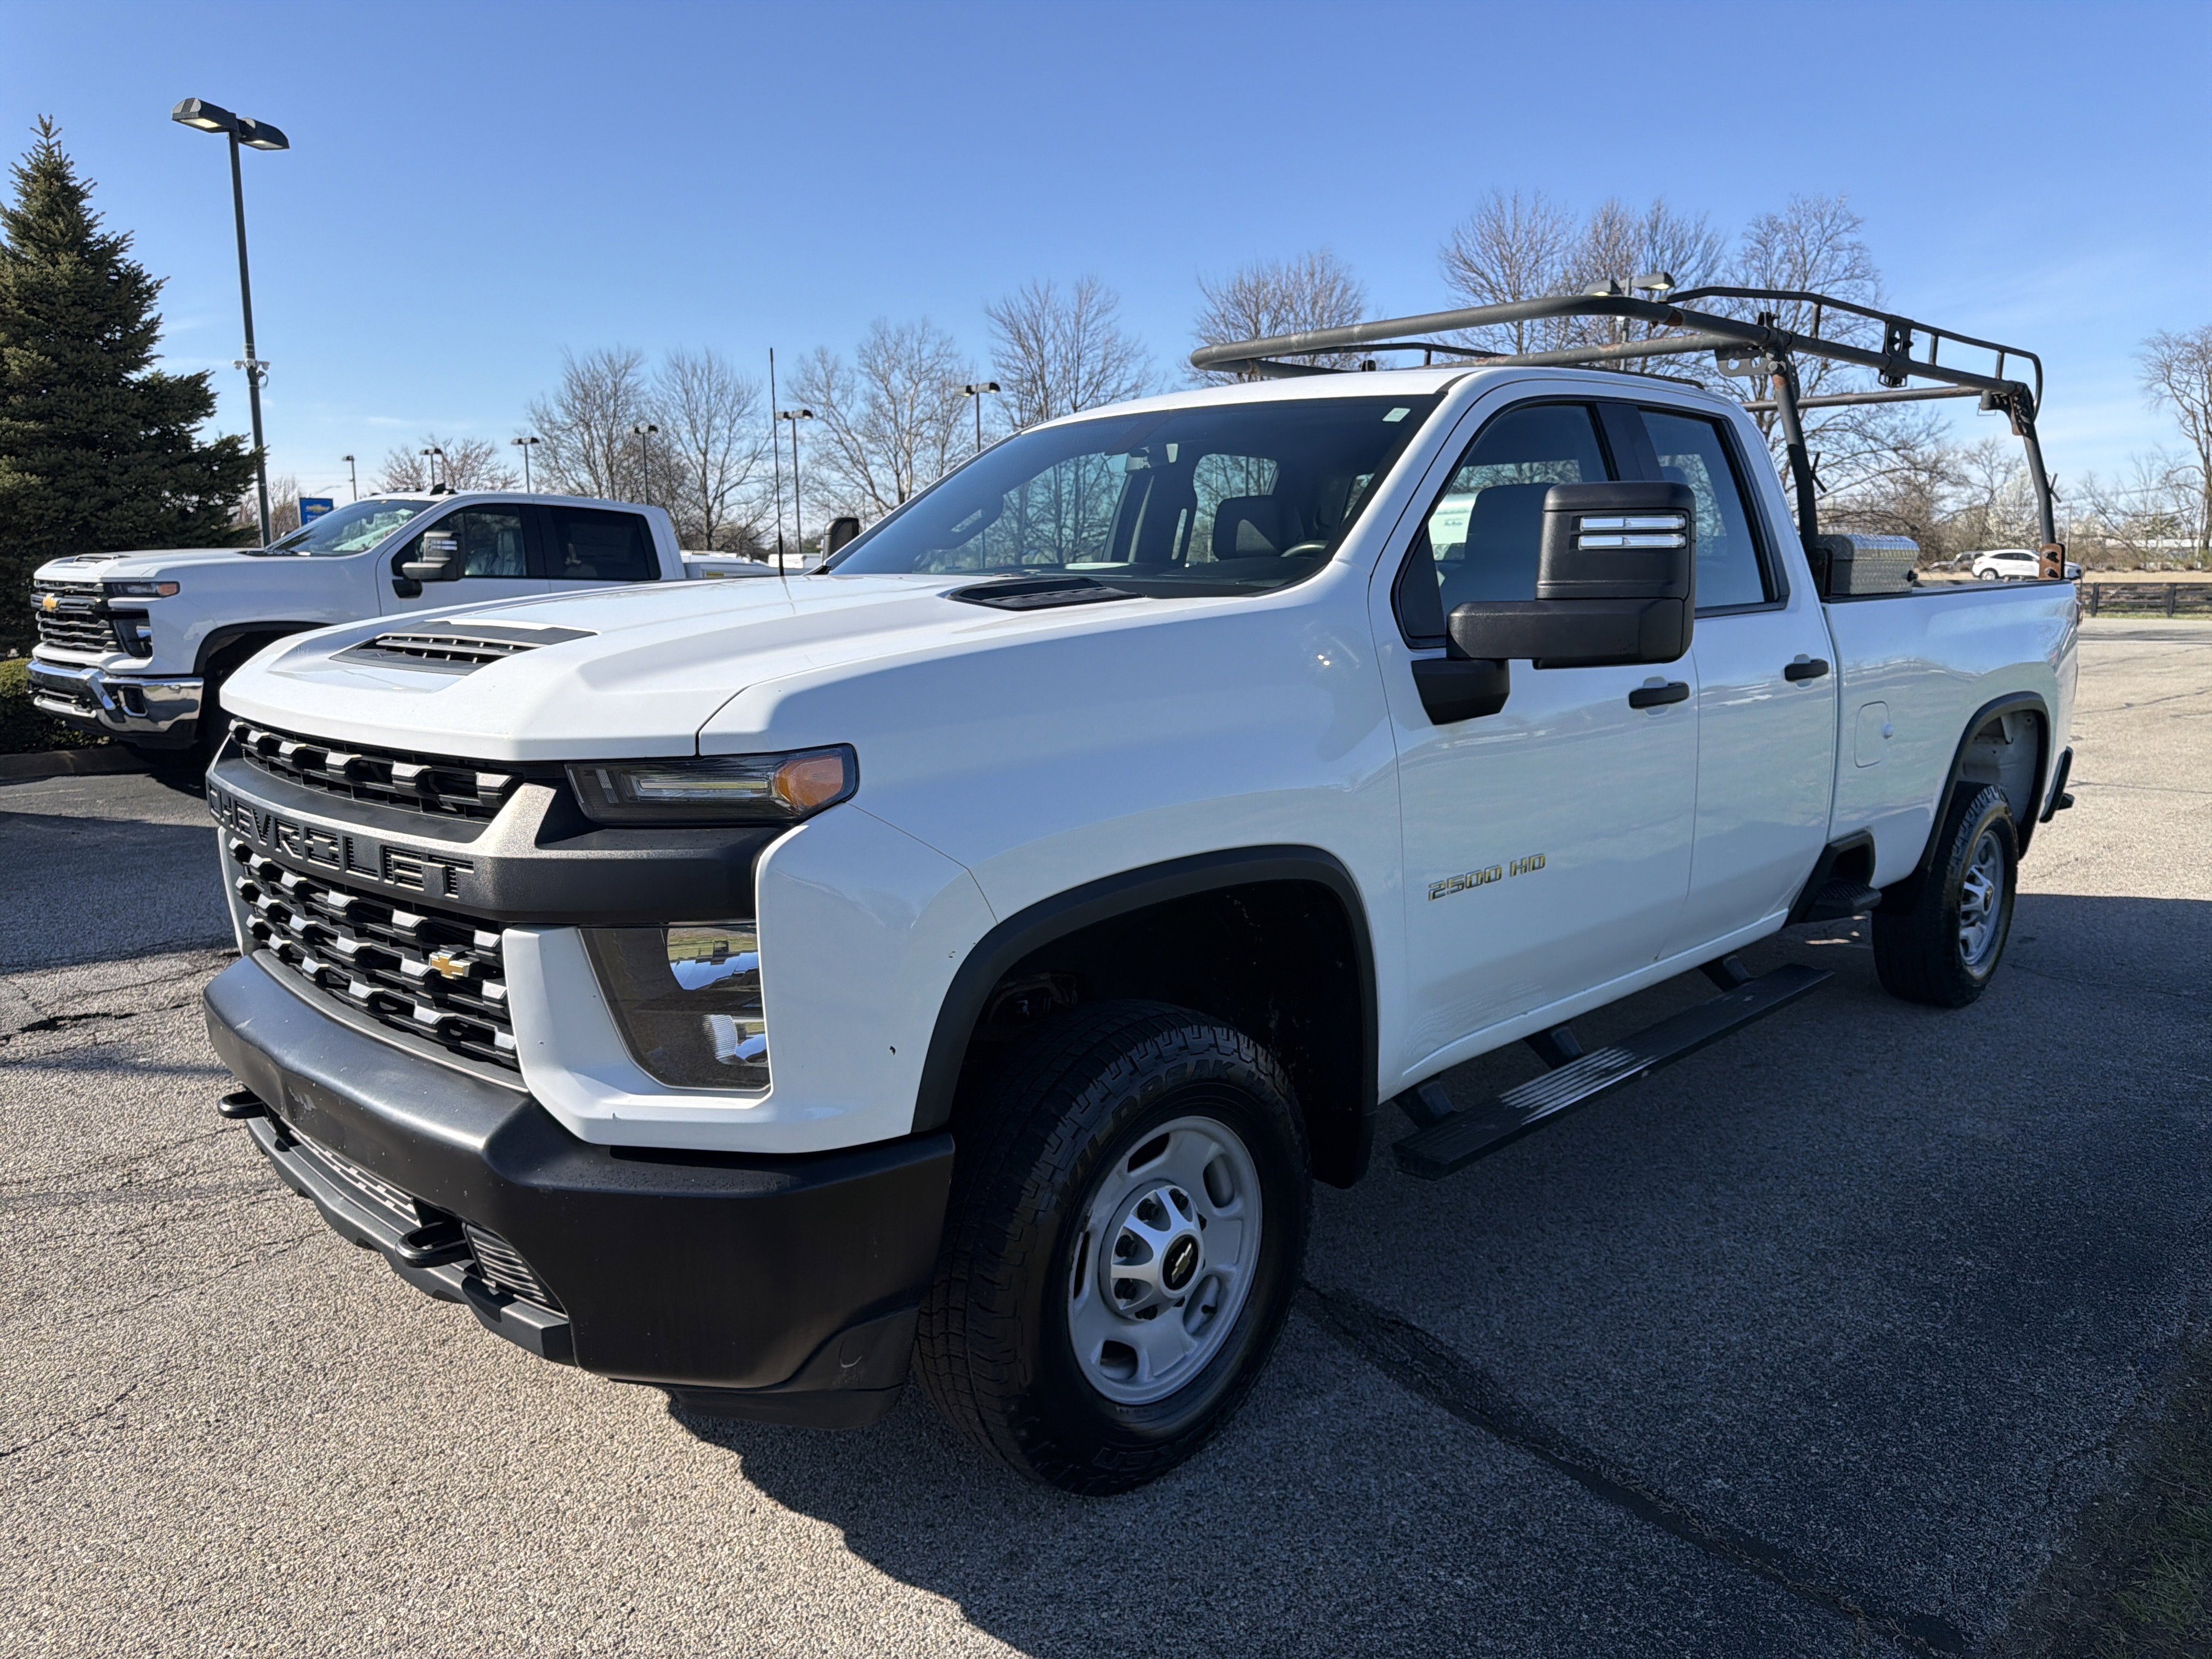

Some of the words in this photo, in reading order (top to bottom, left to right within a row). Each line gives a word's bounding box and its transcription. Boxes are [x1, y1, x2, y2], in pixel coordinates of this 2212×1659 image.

[209, 783, 475, 900] CHEVROLET
[1428, 865, 1503, 901] 2500
[1510, 853, 1546, 877] HD
